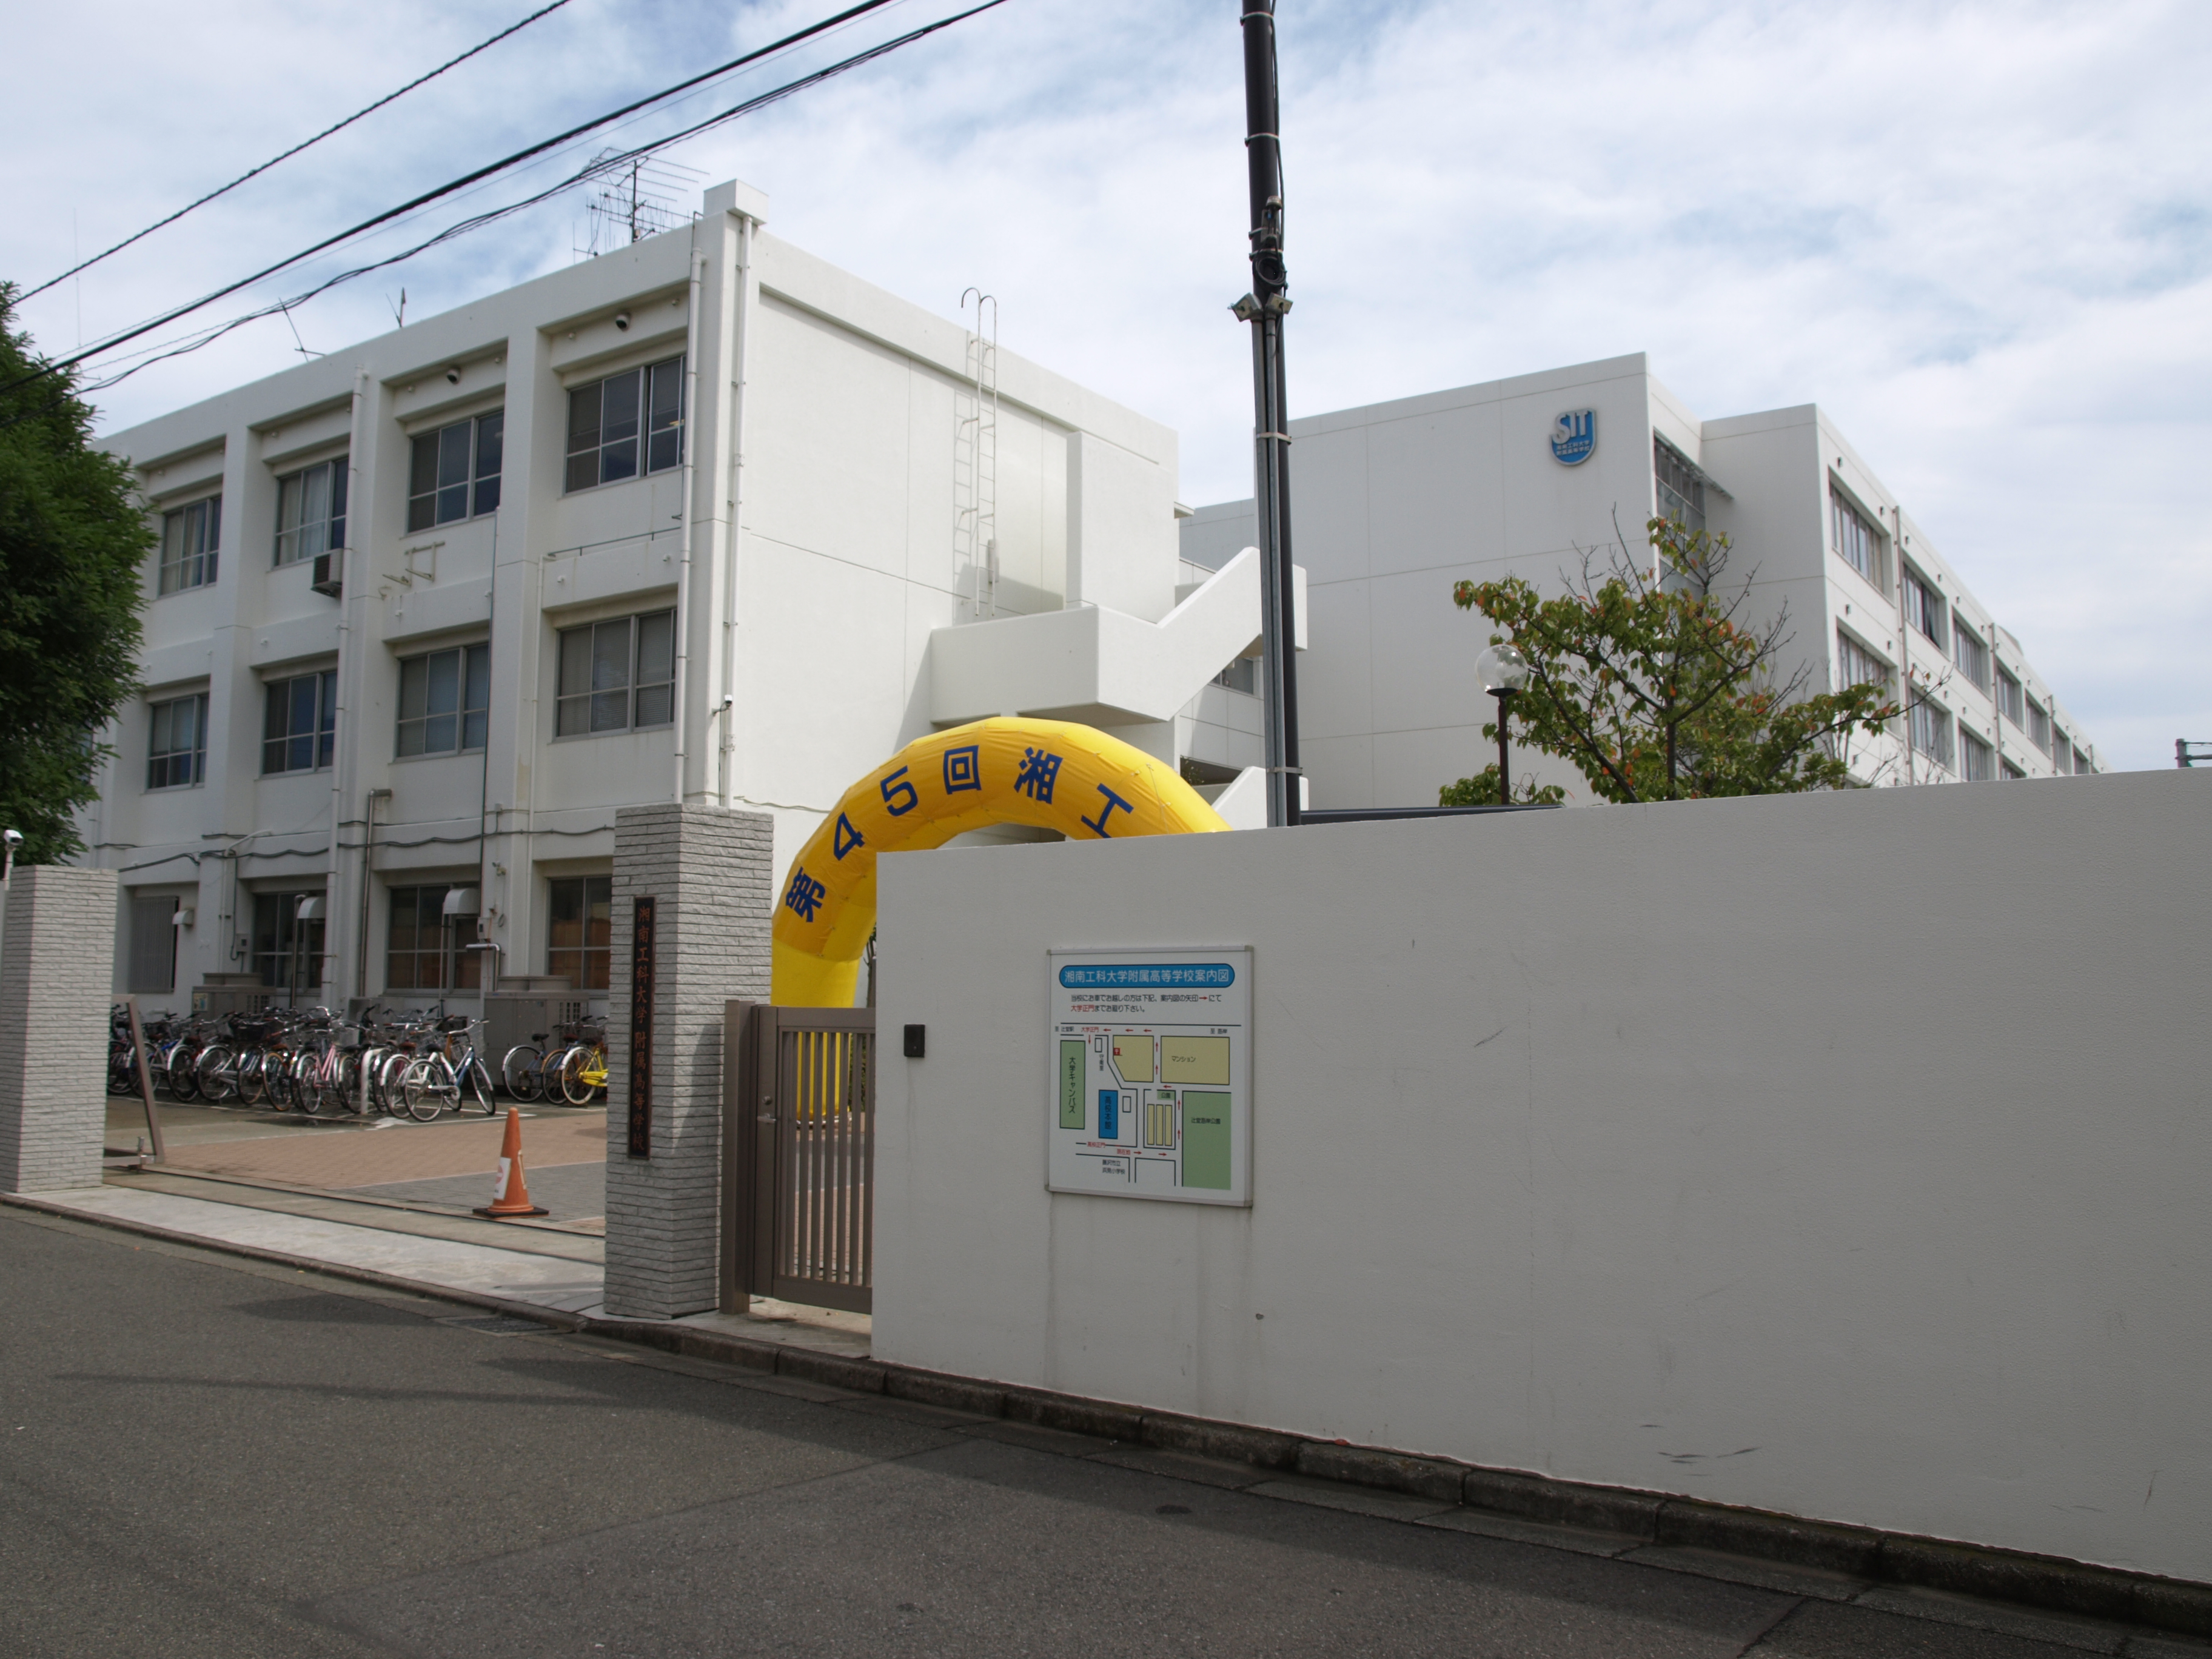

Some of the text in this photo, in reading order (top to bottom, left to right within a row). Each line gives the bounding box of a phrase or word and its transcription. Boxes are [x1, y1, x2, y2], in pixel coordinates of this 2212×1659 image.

[1064, 969, 1229, 983] 湘南工科大学附属高等学校案内図
